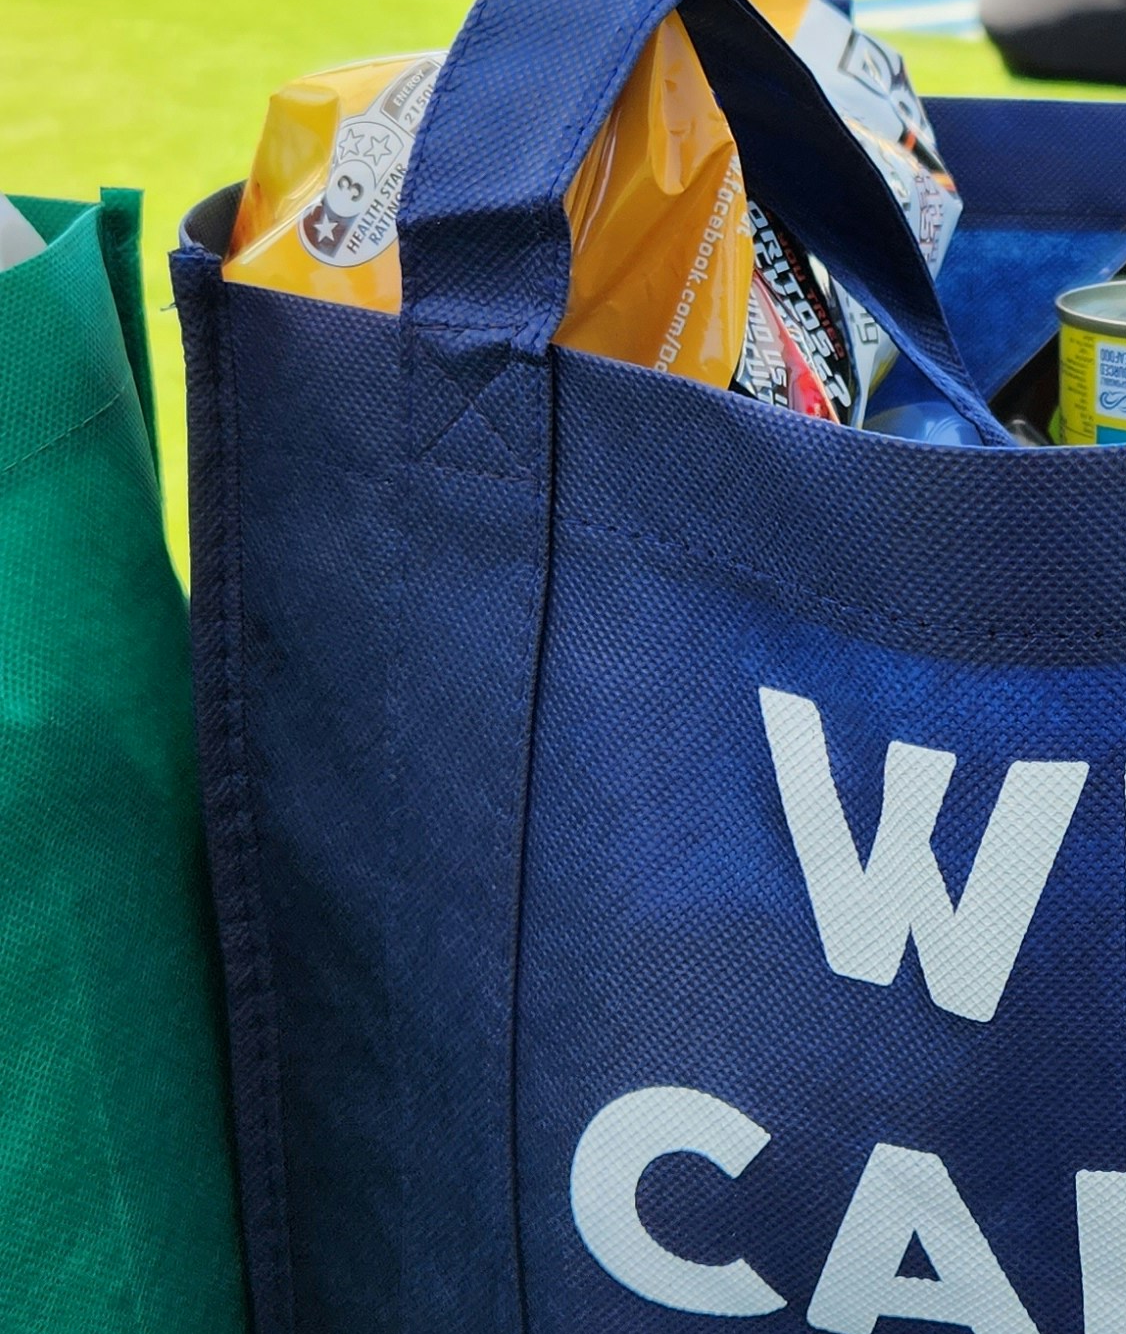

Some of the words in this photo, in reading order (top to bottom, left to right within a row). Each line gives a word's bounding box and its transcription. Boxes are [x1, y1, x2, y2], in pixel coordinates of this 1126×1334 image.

[393, 69, 425, 107] ENERGY
[336, 174, 365, 203] 3
[346, 198, 384, 255] HEALTH
[380, 163, 408, 200] STAR
